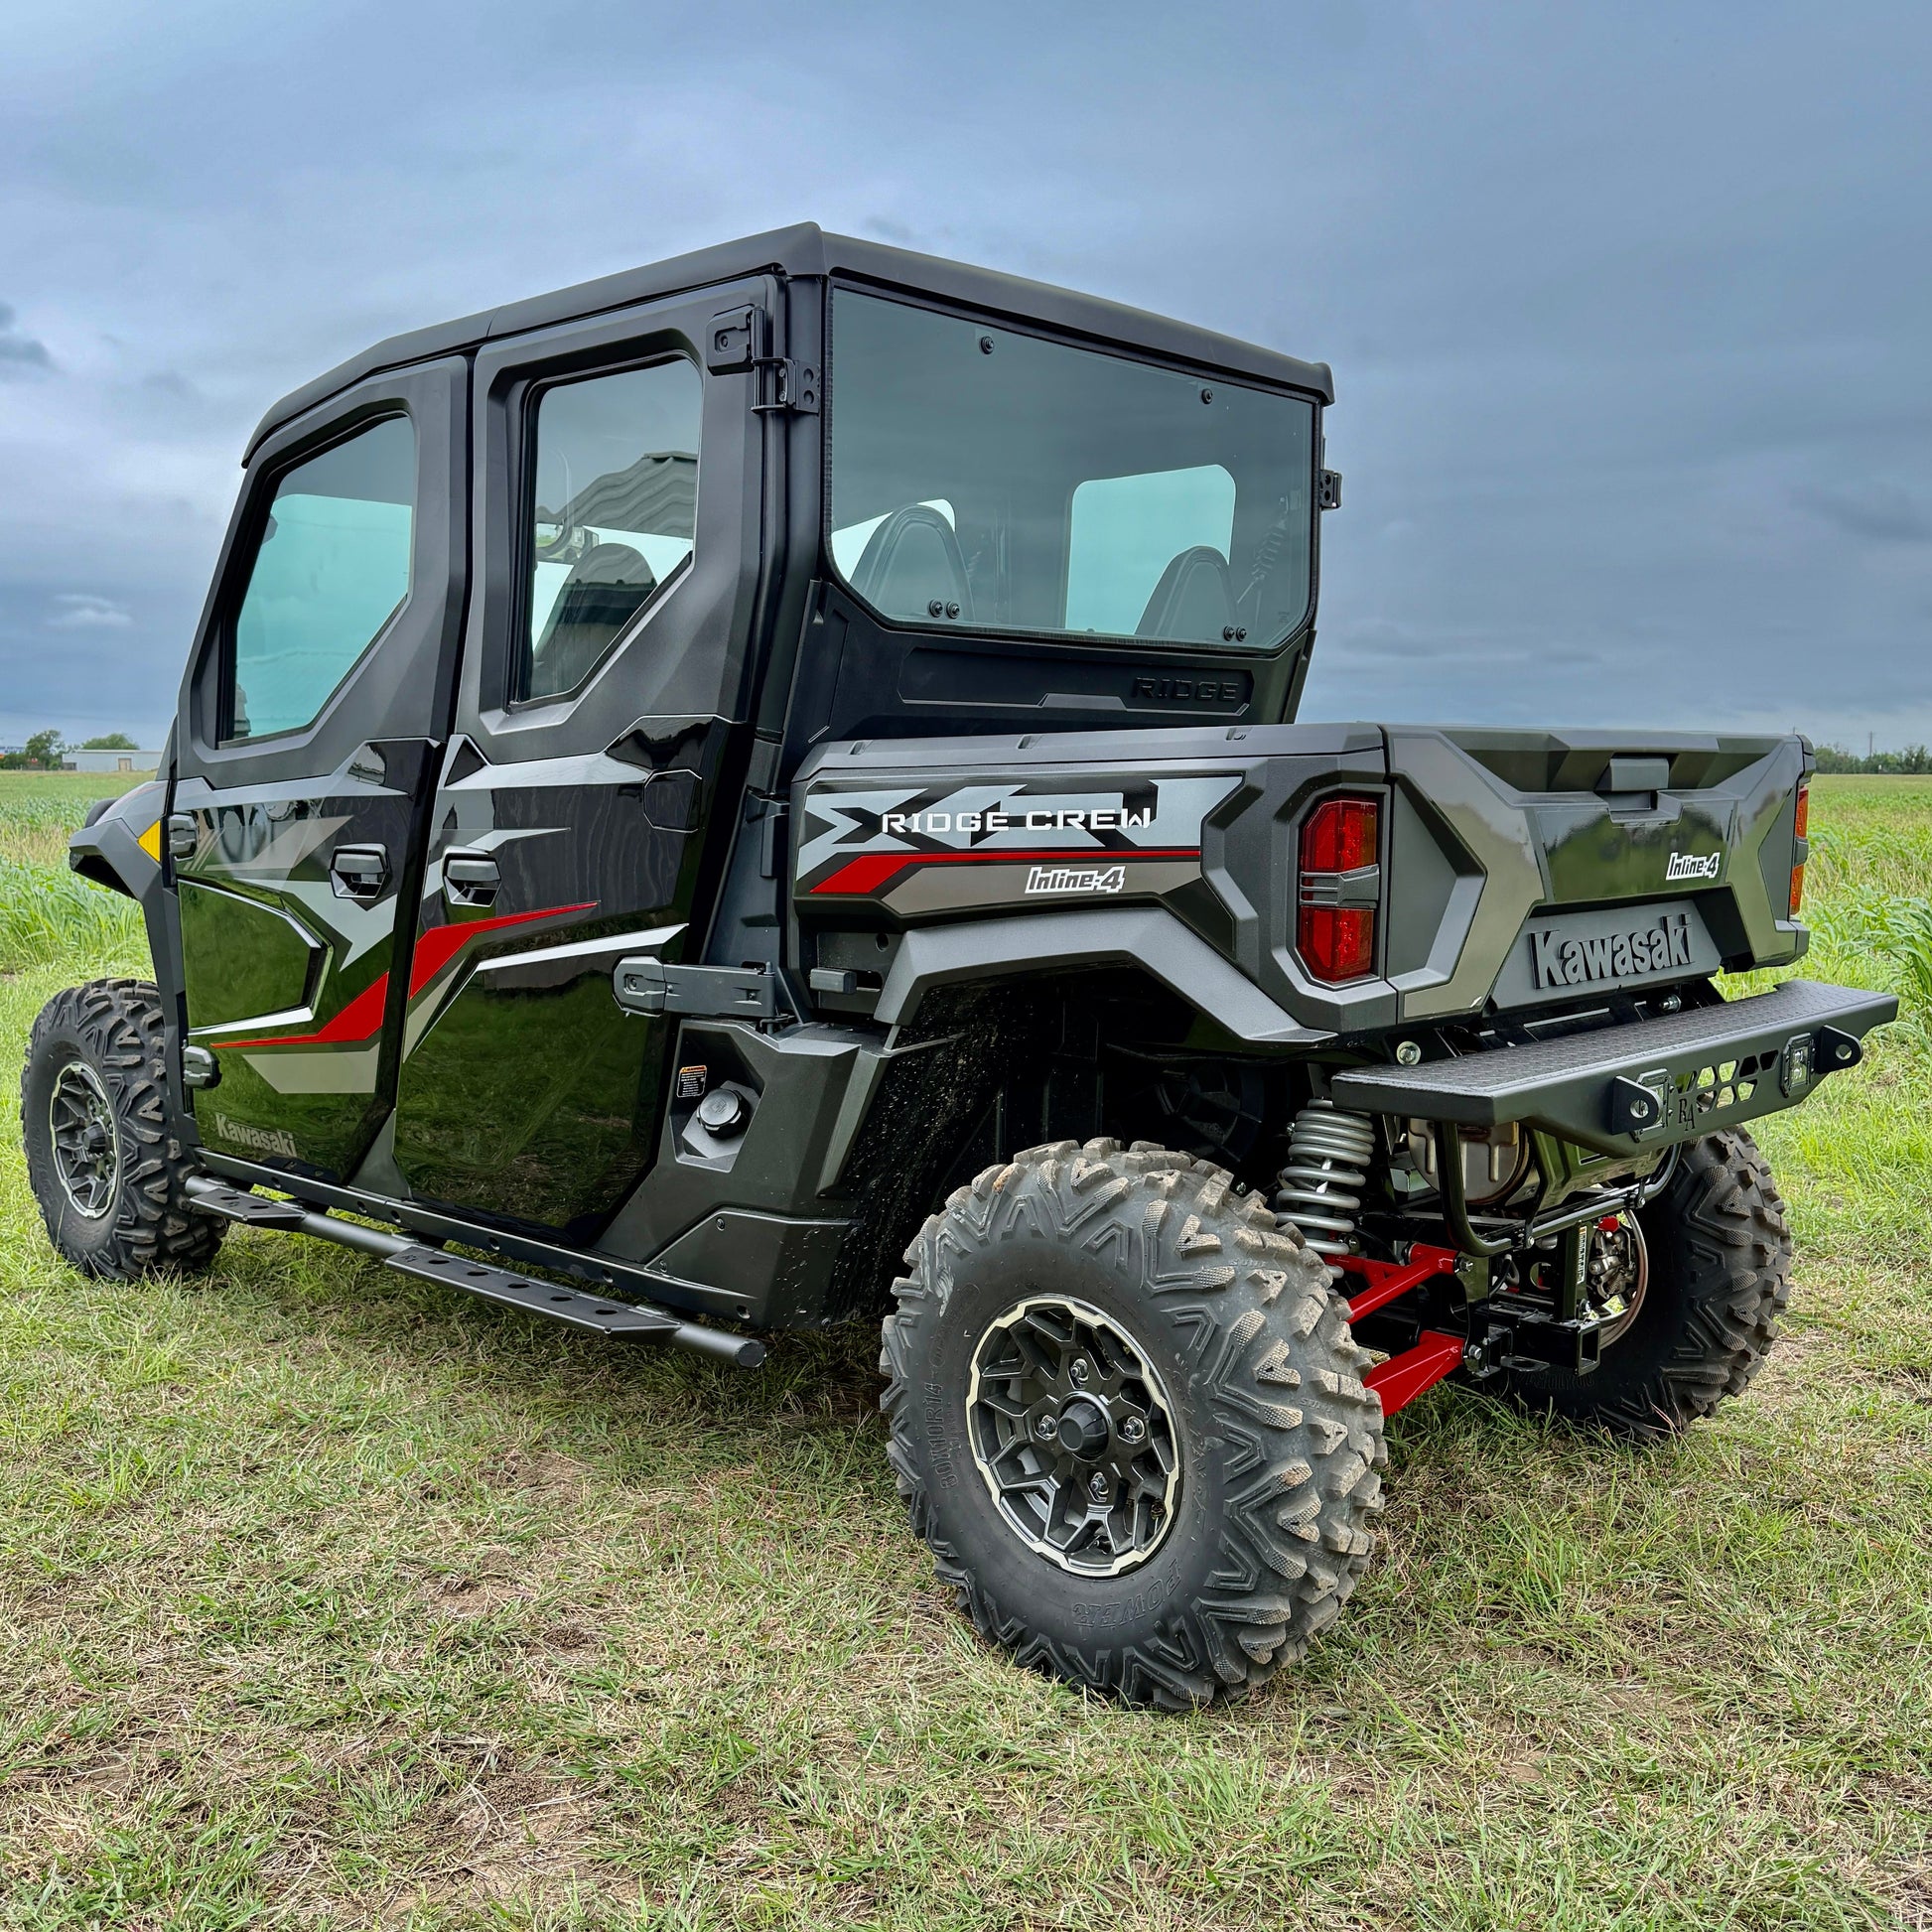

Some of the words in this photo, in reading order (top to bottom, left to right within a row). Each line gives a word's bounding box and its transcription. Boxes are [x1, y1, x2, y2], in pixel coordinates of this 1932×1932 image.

[1131, 677, 1239, 701] RIDGE
[882, 811, 1009, 833] RIDGE
[1026, 807, 1152, 832] CREW
[1529, 912, 1696, 990] Kawasaki
[215, 1112, 298, 1158] Kawasaki
[1071, 1557, 1182, 1628] POWER
